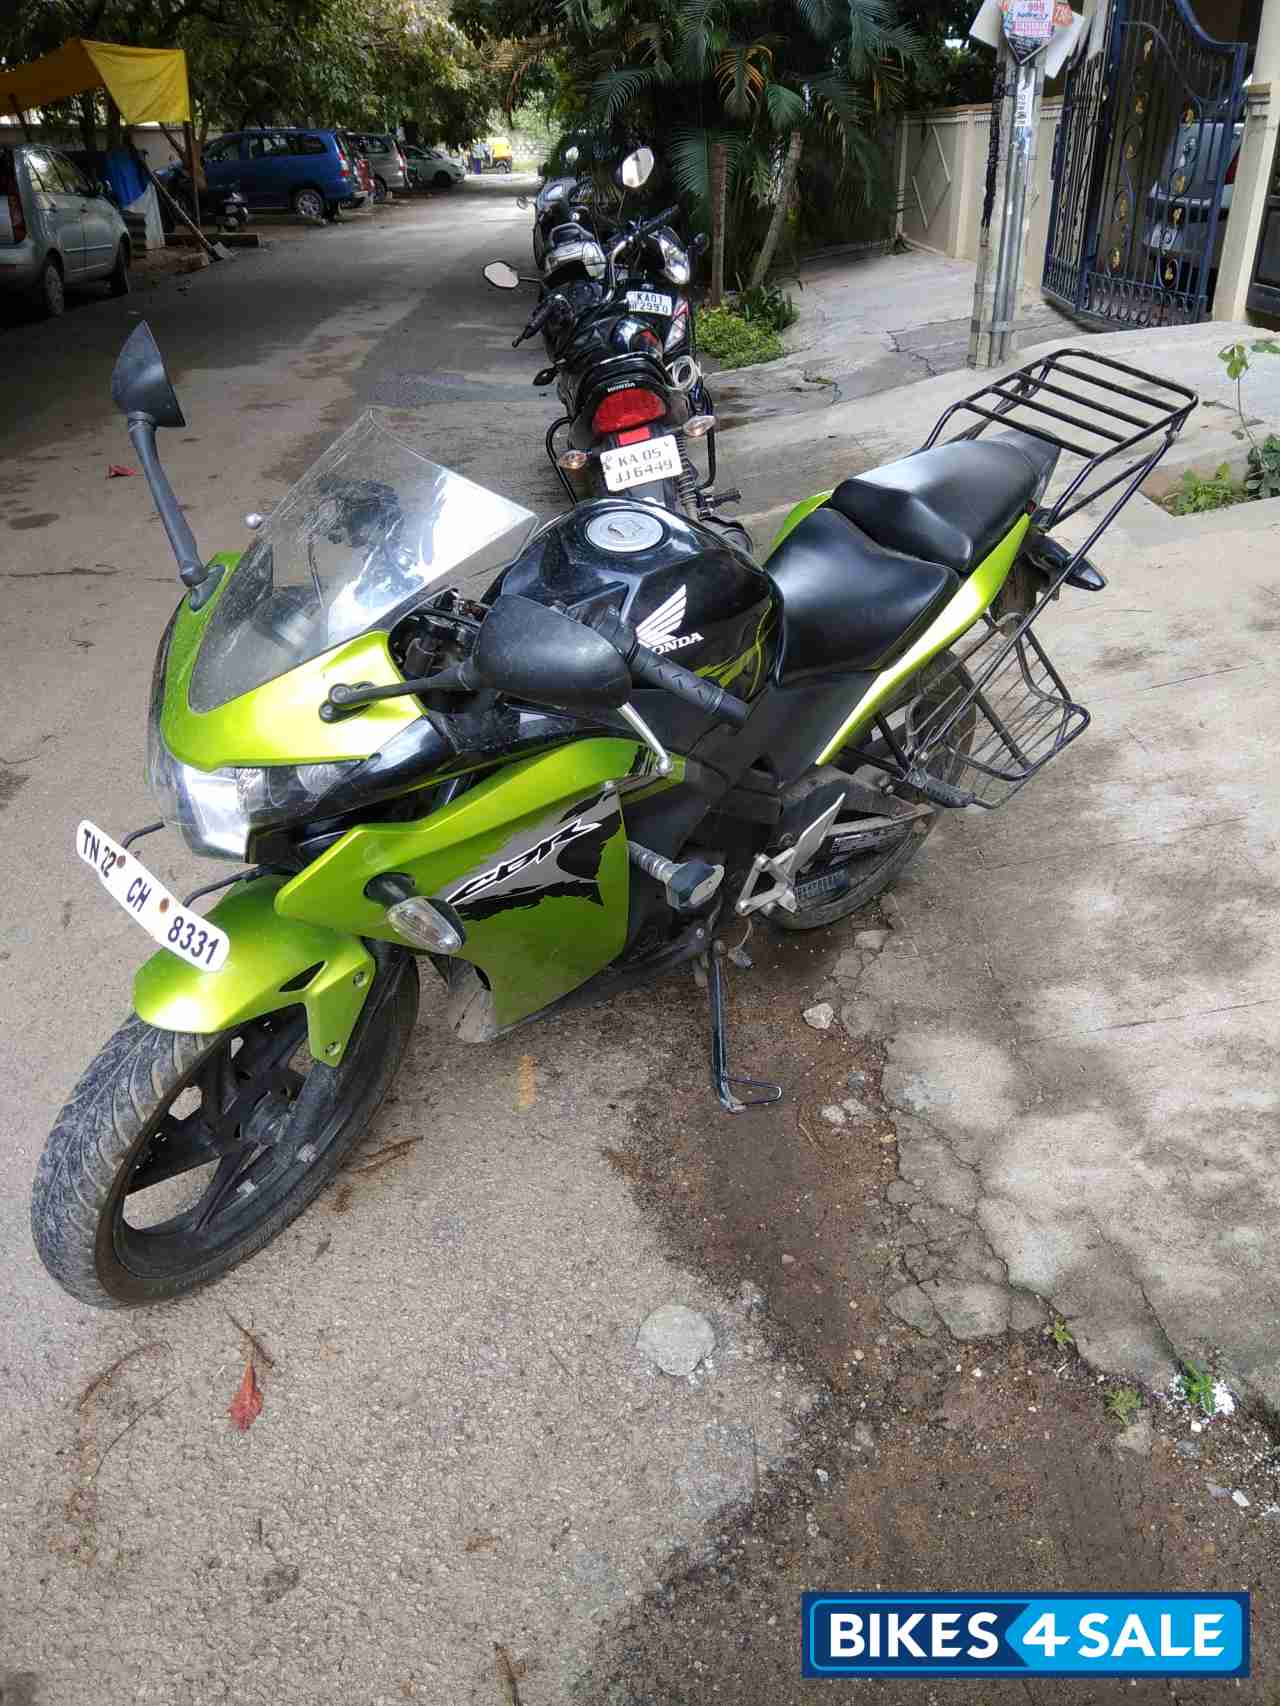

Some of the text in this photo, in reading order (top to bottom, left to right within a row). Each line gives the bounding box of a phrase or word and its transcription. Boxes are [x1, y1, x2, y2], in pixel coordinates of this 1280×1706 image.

[618, 453, 639, 467] KA
[651, 632, 704, 656] ONDA
[126, 877, 152, 913] CH
[167, 915, 220, 965] 8331
